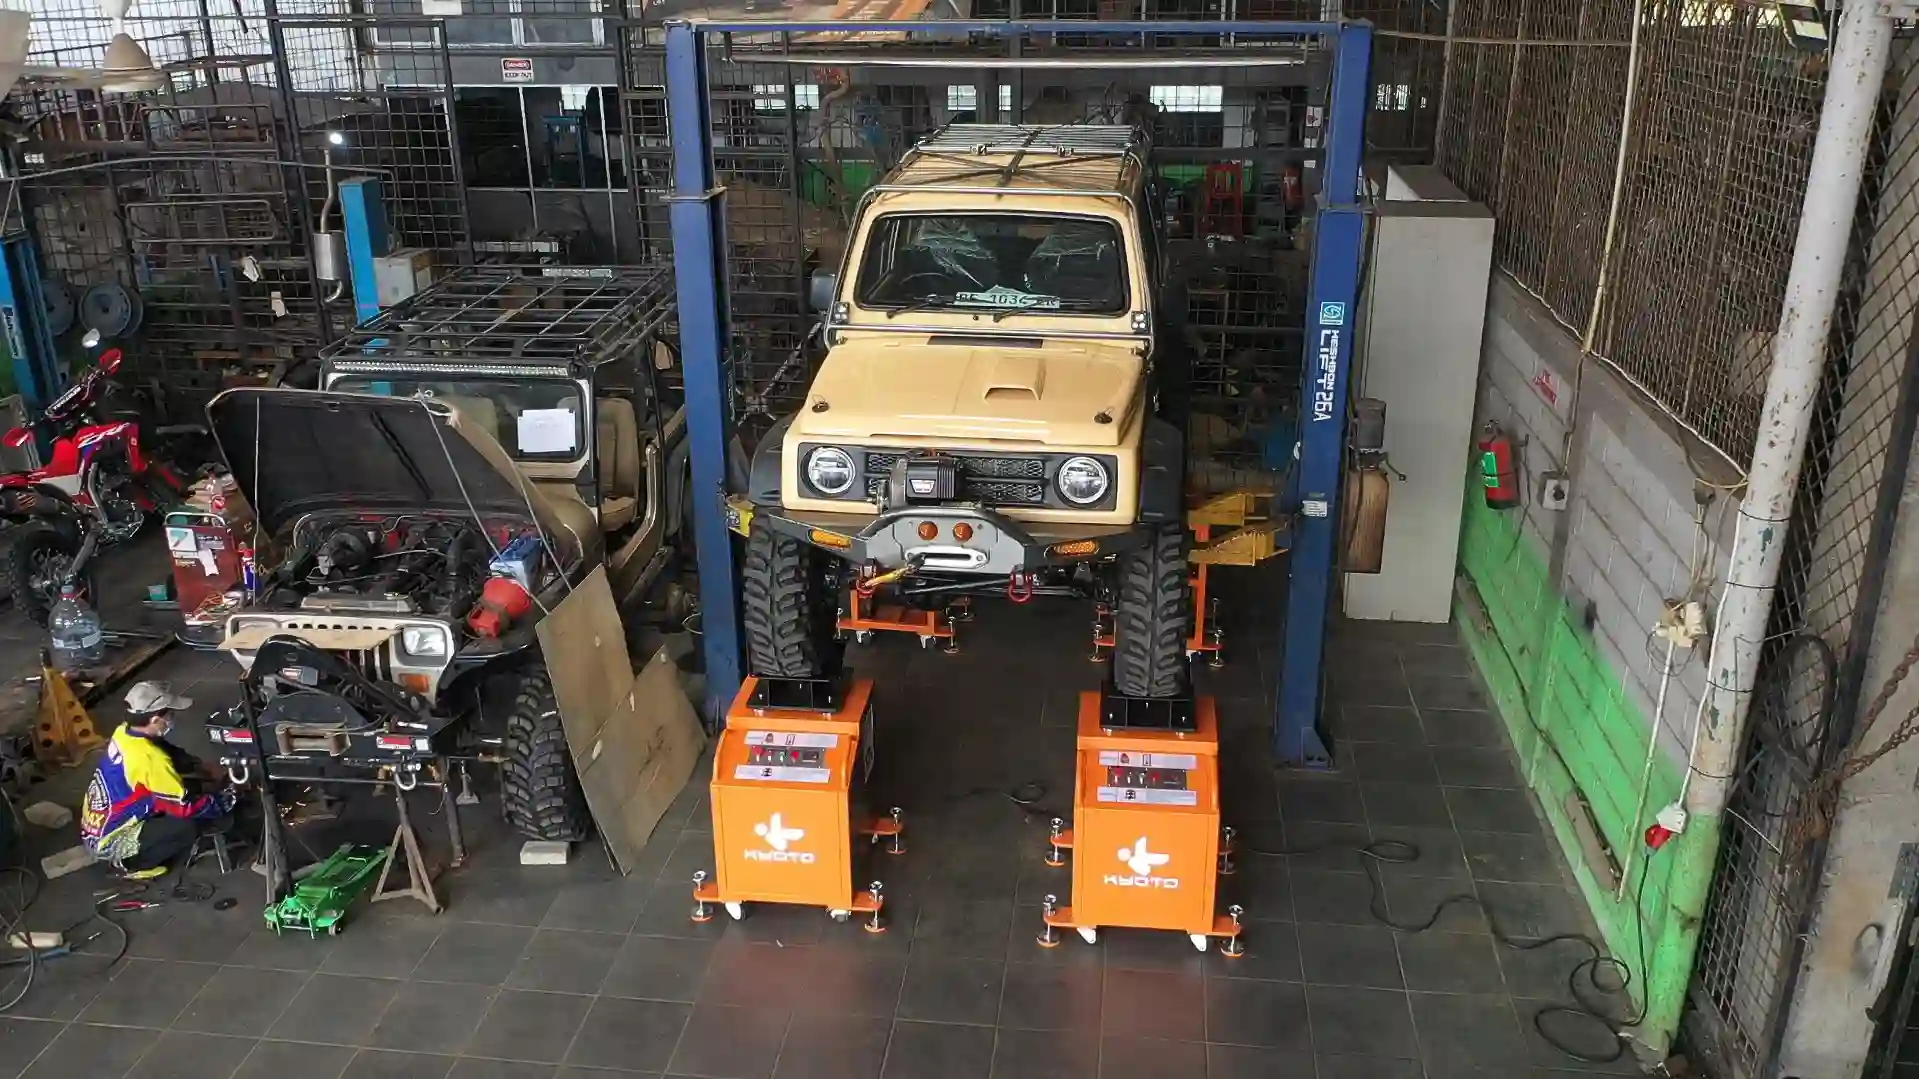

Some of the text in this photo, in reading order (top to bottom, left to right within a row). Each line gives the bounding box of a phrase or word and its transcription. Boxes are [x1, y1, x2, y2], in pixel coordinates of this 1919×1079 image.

[1317, 329, 1331, 390] LIFT
[1313, 391, 1334, 422] 26A
[743, 848, 816, 865] KYOTO
[1103, 875, 1179, 889] KYOTO
